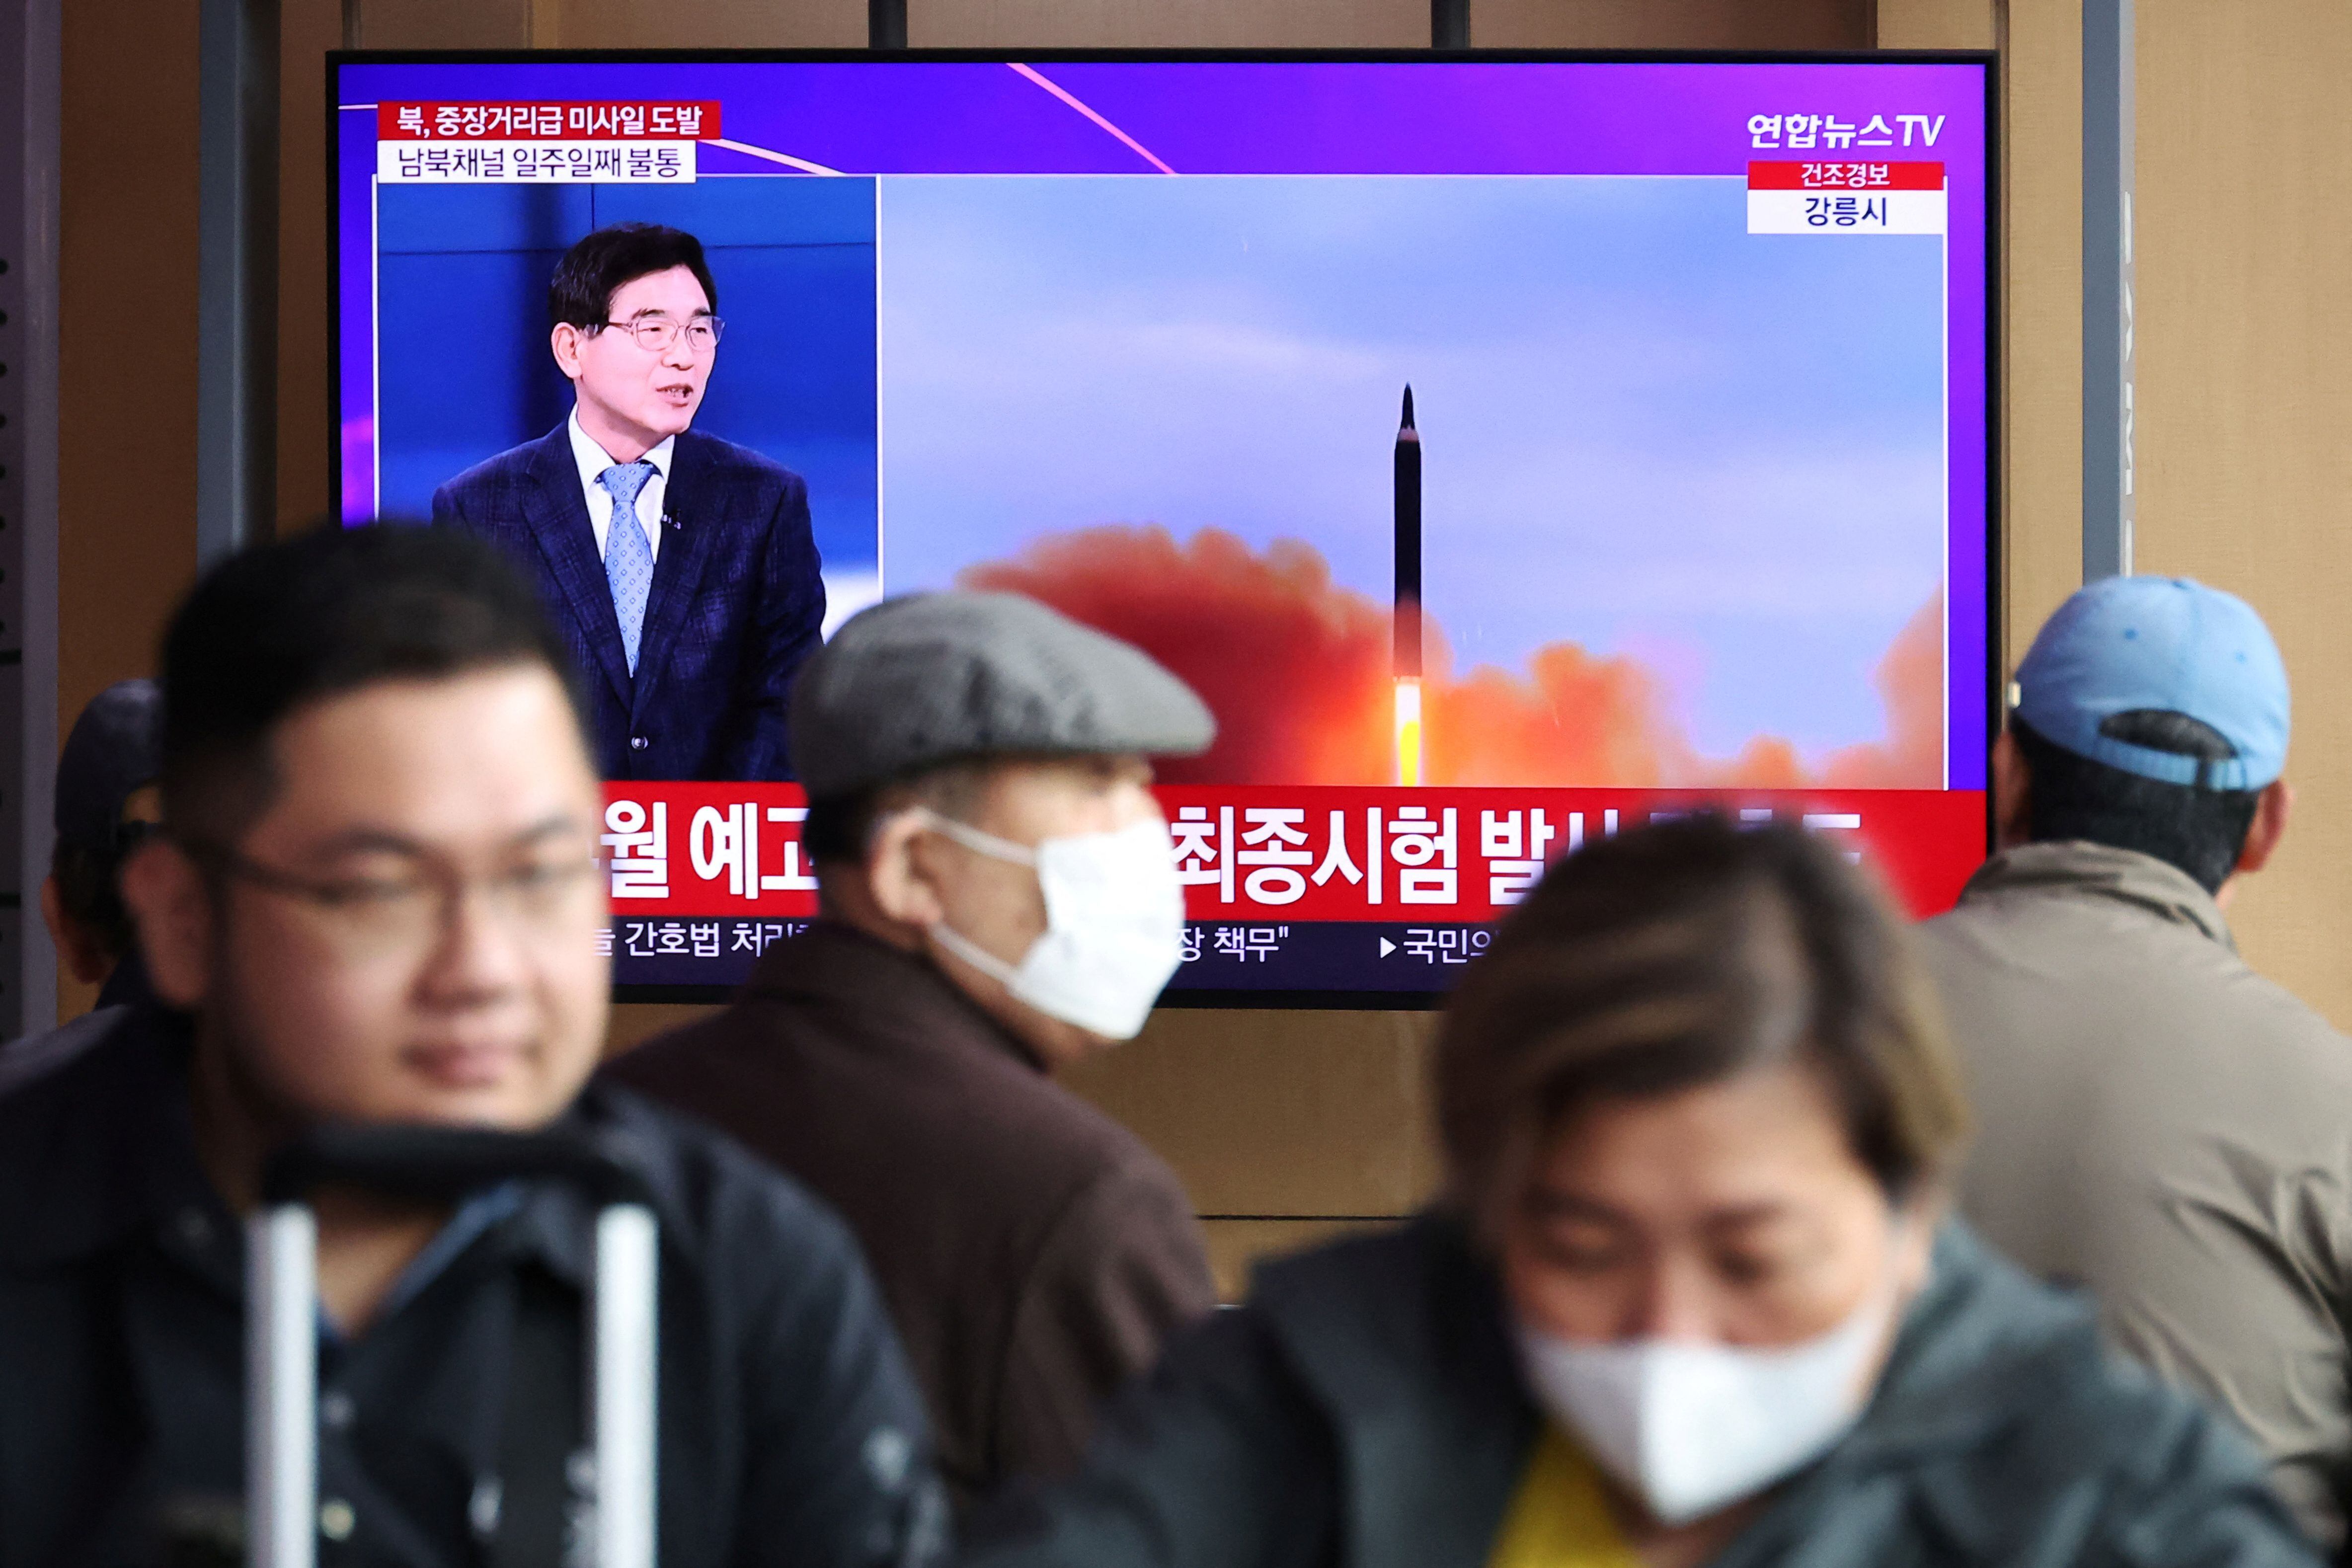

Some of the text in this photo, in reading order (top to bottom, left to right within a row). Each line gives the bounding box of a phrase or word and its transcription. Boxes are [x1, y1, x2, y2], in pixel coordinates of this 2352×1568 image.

[397, 105, 703, 139] 북, 중장거리급 미사일 도발
[1747, 113, 1946, 149] 연합뉴스TV
[398, 148, 681, 178] 남북채널 일주일째 불통
[1801, 163, 1890, 187] 건조경보
[1805, 196, 1887, 227] 강릉시
[590, 799, 670, 899] 월
[1169, 805, 1458, 905] 최종시험
[624, 922, 720, 957] 간호법
[730, 922, 809, 958] 처리
[1213, 926, 1289, 963] 책무"
